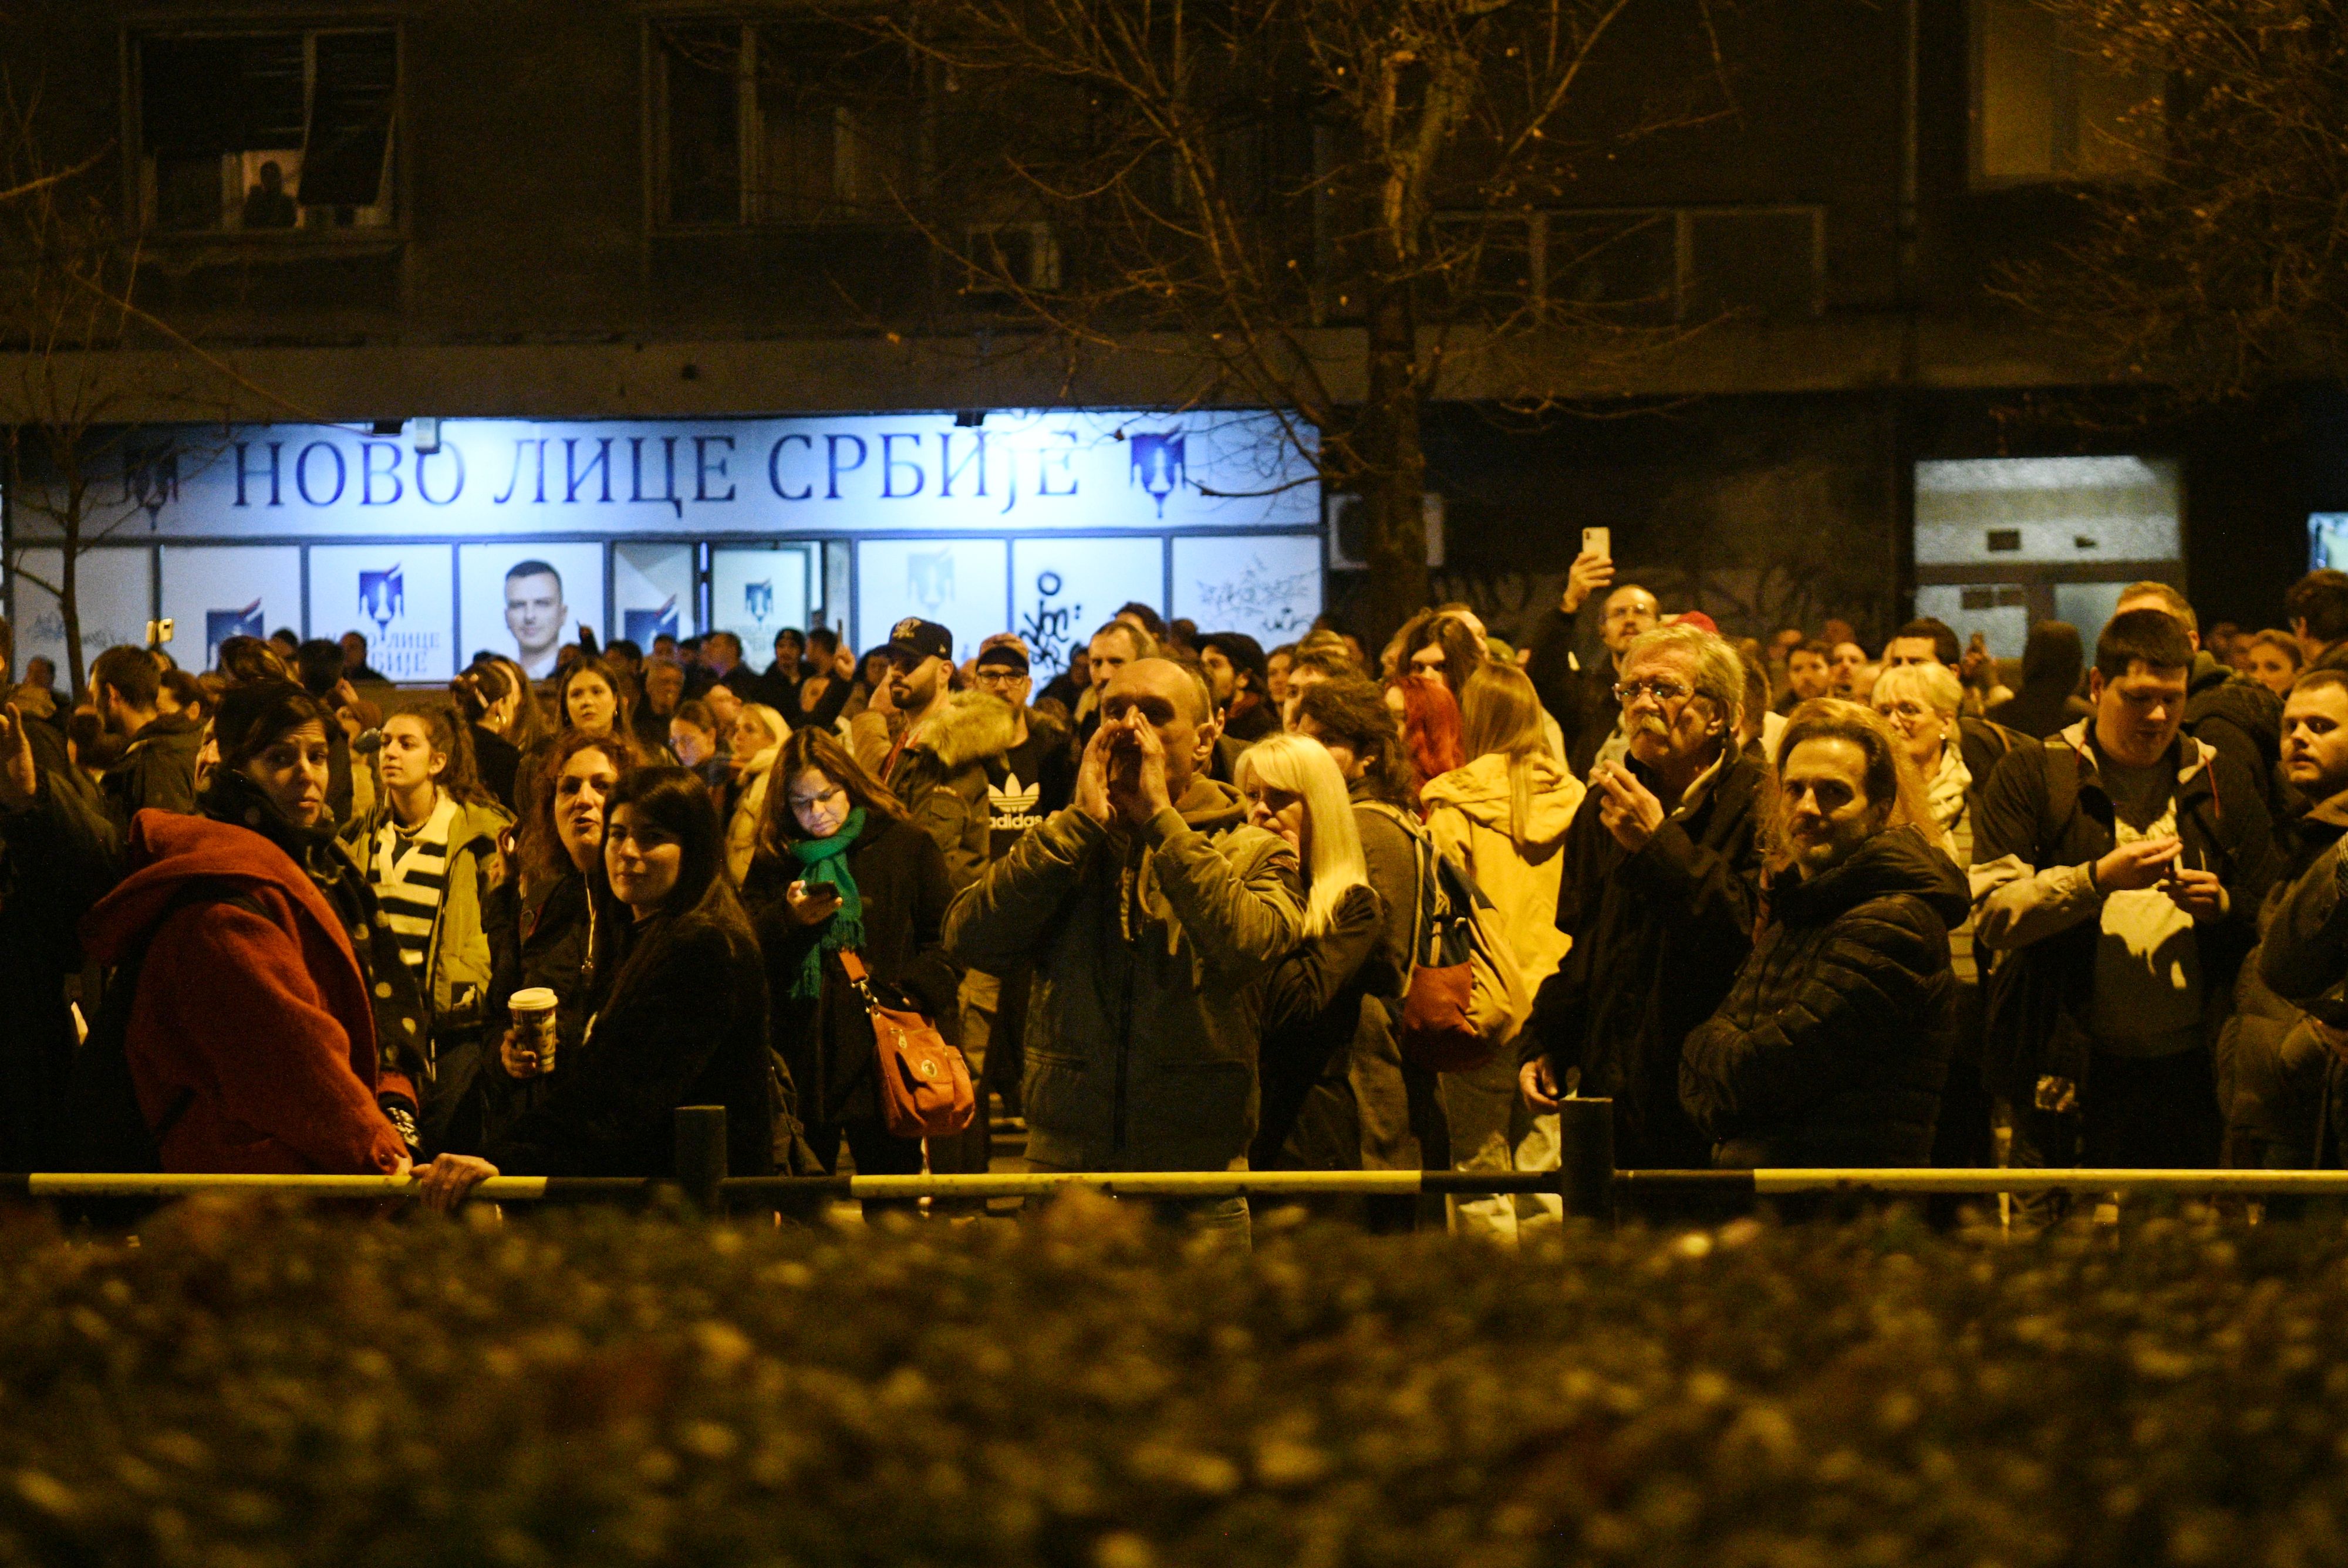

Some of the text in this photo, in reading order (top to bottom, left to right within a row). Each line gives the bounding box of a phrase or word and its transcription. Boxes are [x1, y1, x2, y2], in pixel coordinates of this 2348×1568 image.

[232, 430, 1078, 518] НОВО ЛИЦЕ СРБИЈЕ
[370, 651, 428, 676] БИЈЕ
[989, 813, 1043, 830] adidas
